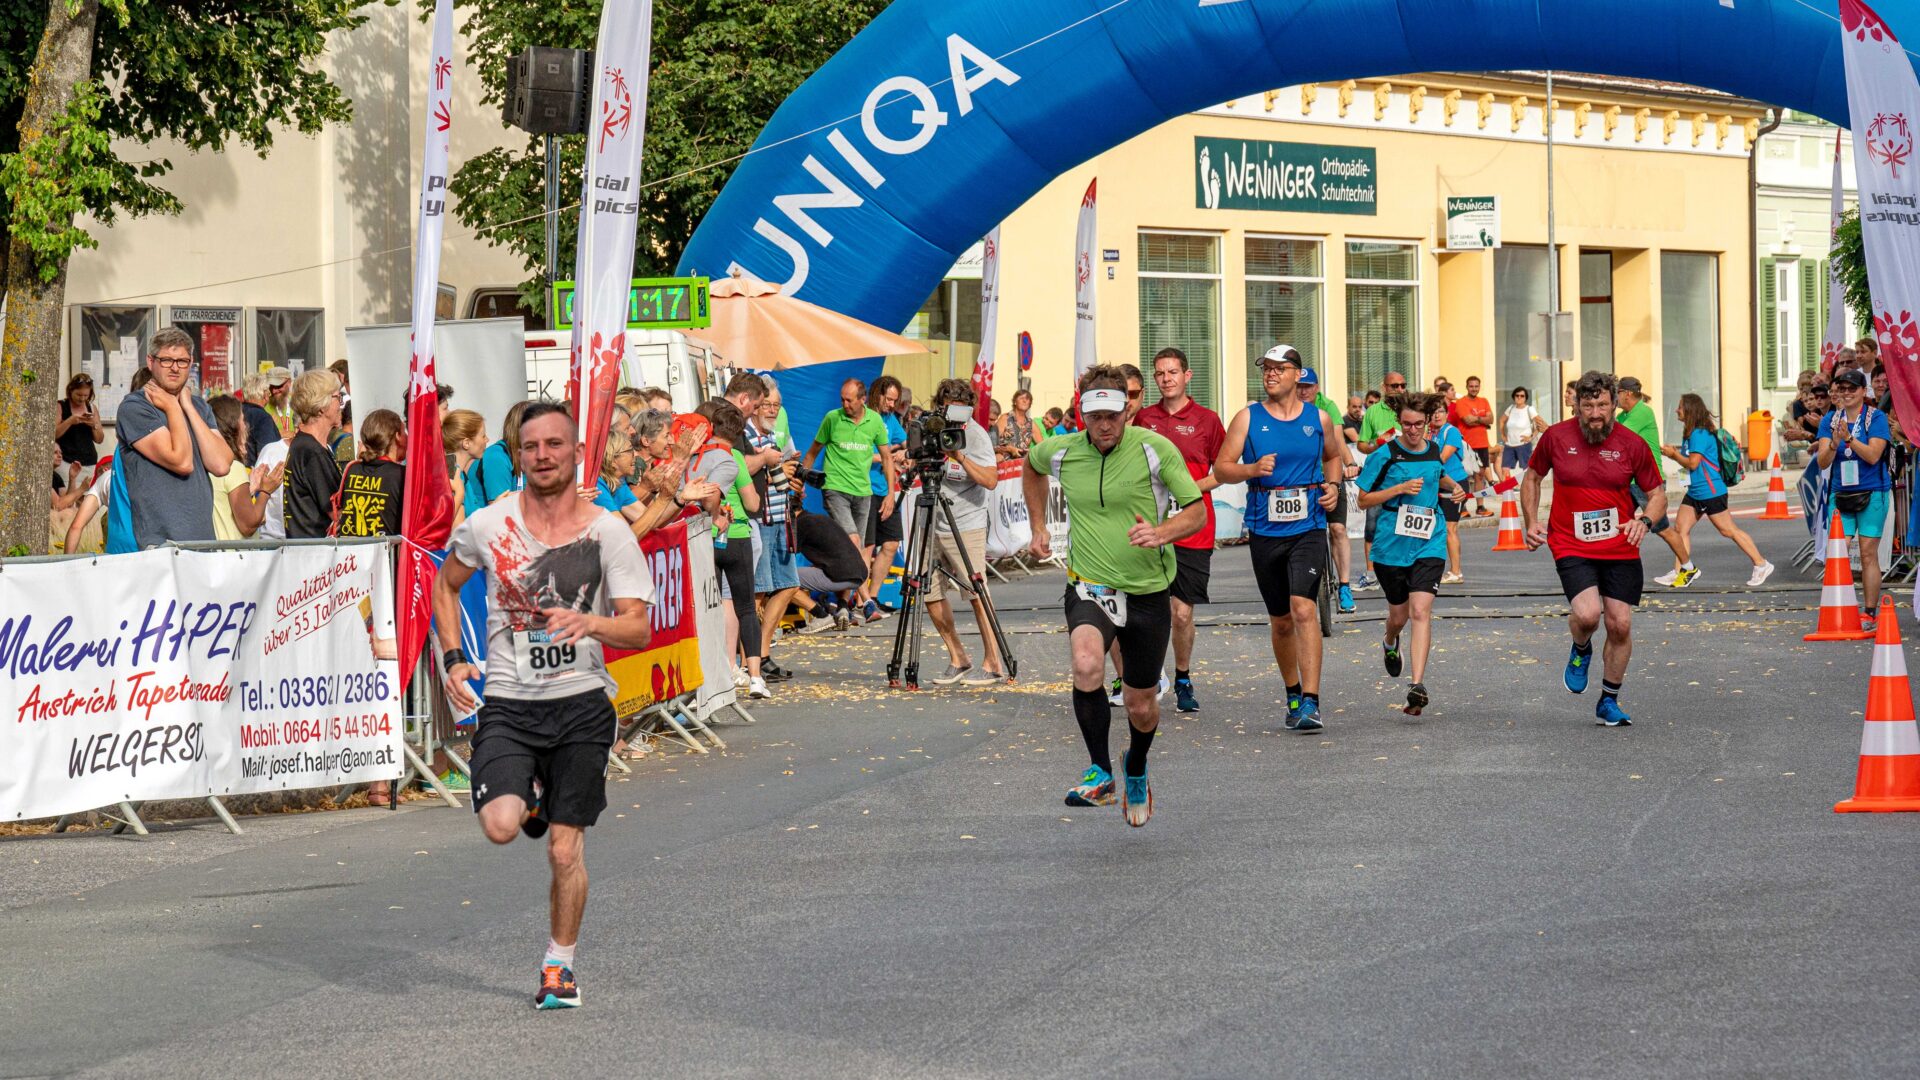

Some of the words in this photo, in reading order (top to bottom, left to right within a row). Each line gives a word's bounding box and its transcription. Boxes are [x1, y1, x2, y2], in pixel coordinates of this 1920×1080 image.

[726, 33, 1021, 297] UNIQA
[1321, 157, 1371, 180] Orthopädie-
[1321, 183, 1375, 203] Schuhtechnik
[190, 309, 237, 321] PFARRGEMEINDE
[348, 474, 383, 492] TEAM
[1275, 499, 1301, 514] 808
[1404, 515, 1433, 531] 807
[1582, 518, 1611, 536] 813
[264, 627, 291, 656] über
[294, 607, 310, 636] 55
[0, 614, 128, 680] Malerei
[529, 643, 577, 669] 809
[18, 679, 117, 723] Anstrich
[240, 680, 274, 712] Tel.:
[344, 671, 390, 704] 2386
[240, 722, 281, 748] Mobil:
[284, 719, 321, 744] 0664
[345, 715, 359, 739] 44
[362, 712, 392, 738] 504
[242, 754, 267, 778] Mail:
[269, 744, 396, 781] josef.halper@aon.at
